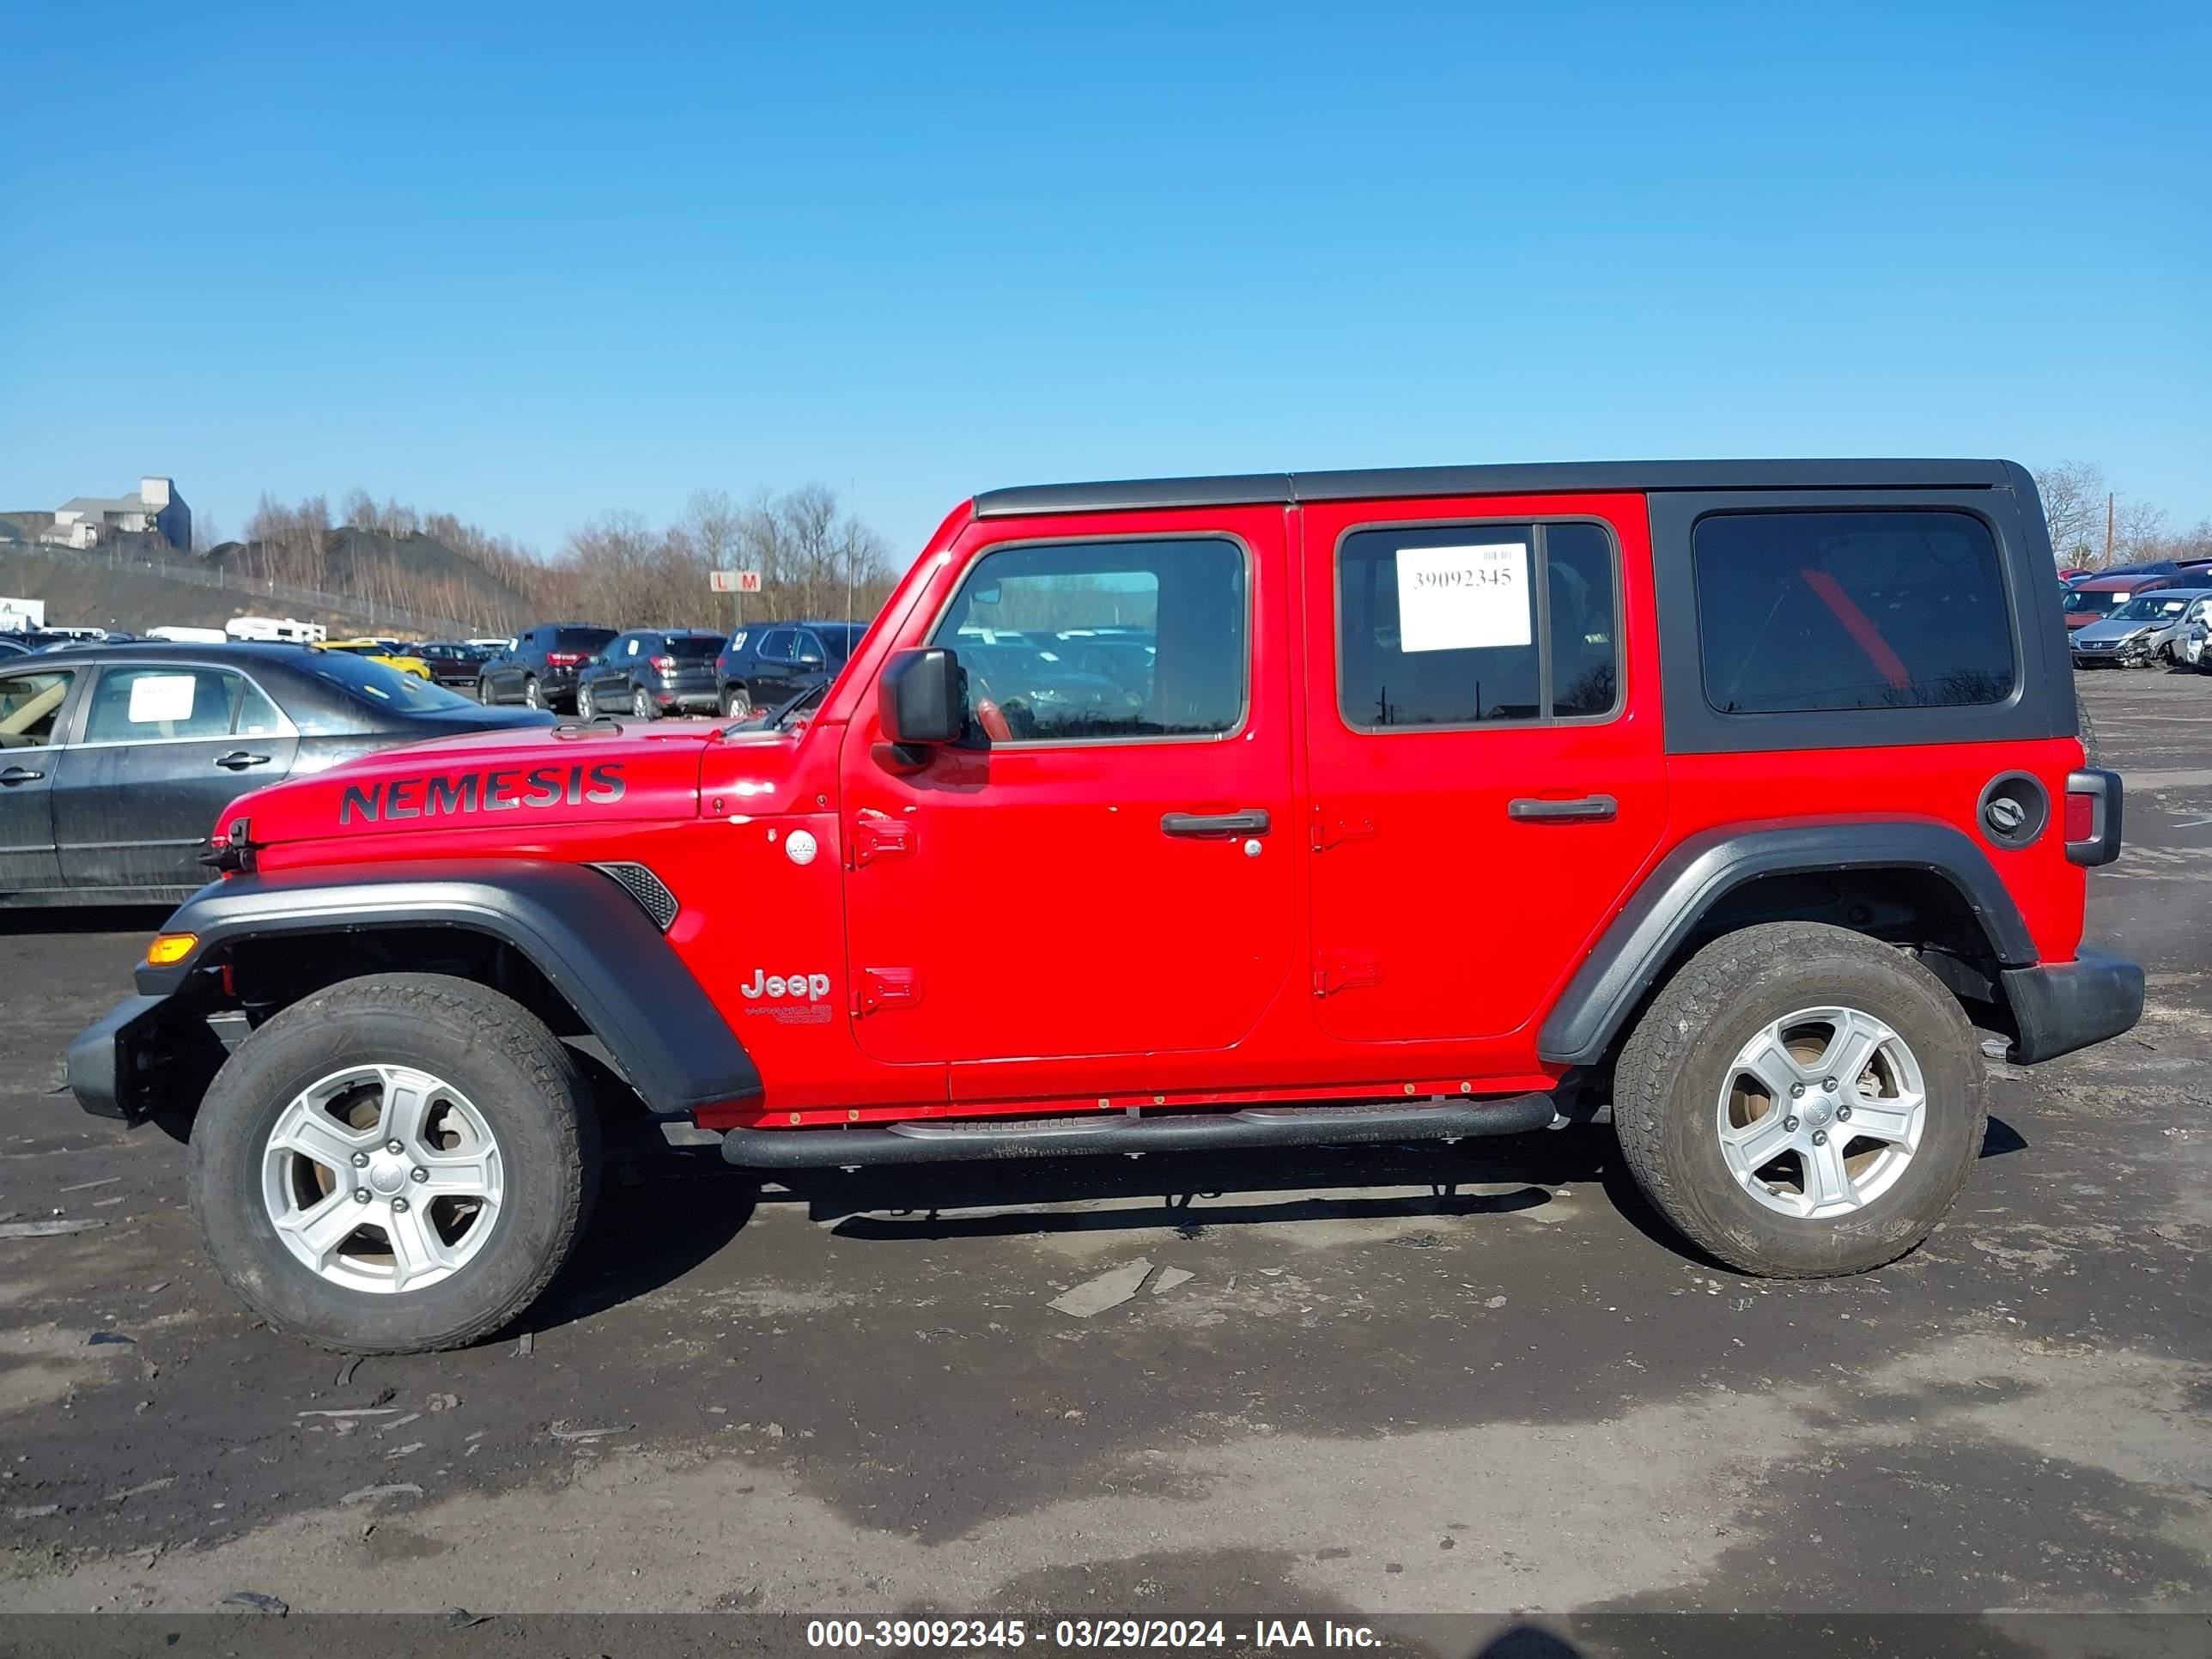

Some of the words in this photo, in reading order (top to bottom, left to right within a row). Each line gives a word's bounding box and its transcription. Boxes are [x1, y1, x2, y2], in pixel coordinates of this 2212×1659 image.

[717, 574, 728, 591] L
[742, 573, 757, 589] M
[1413, 568, 1512, 591] 39092345
[339, 763, 627, 825] NEMESIS
[740, 969, 830, 1002] Jeep
